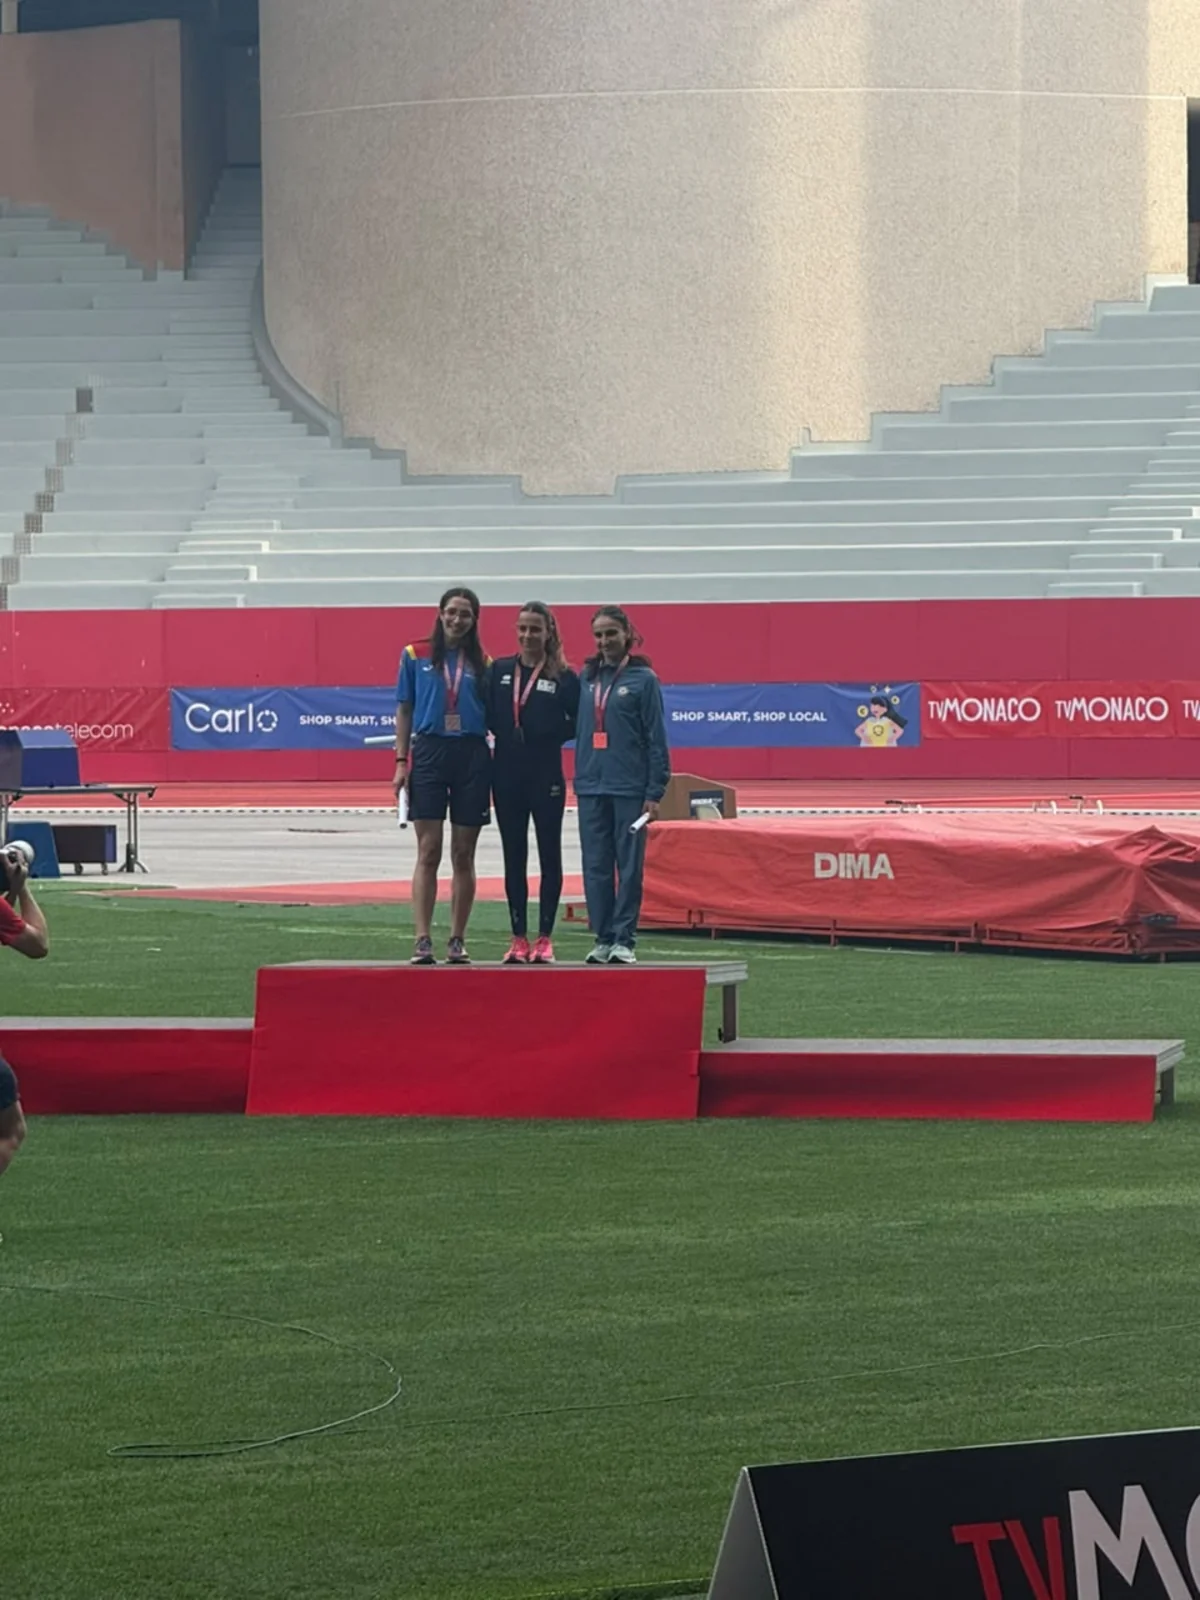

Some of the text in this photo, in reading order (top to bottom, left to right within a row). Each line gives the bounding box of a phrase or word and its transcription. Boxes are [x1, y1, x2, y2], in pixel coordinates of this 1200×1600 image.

[185, 702, 279, 733] Carlo
[299, 714, 332, 726] SHOP
[334, 714, 379, 727] SMART,
[671, 711, 828, 723] SHOP SMART, SHOP LOCAL
[1182, 699, 1200, 721] TV
[813, 852, 895, 880] DIMA
[951, 1484, 1200, 1600] TVM
